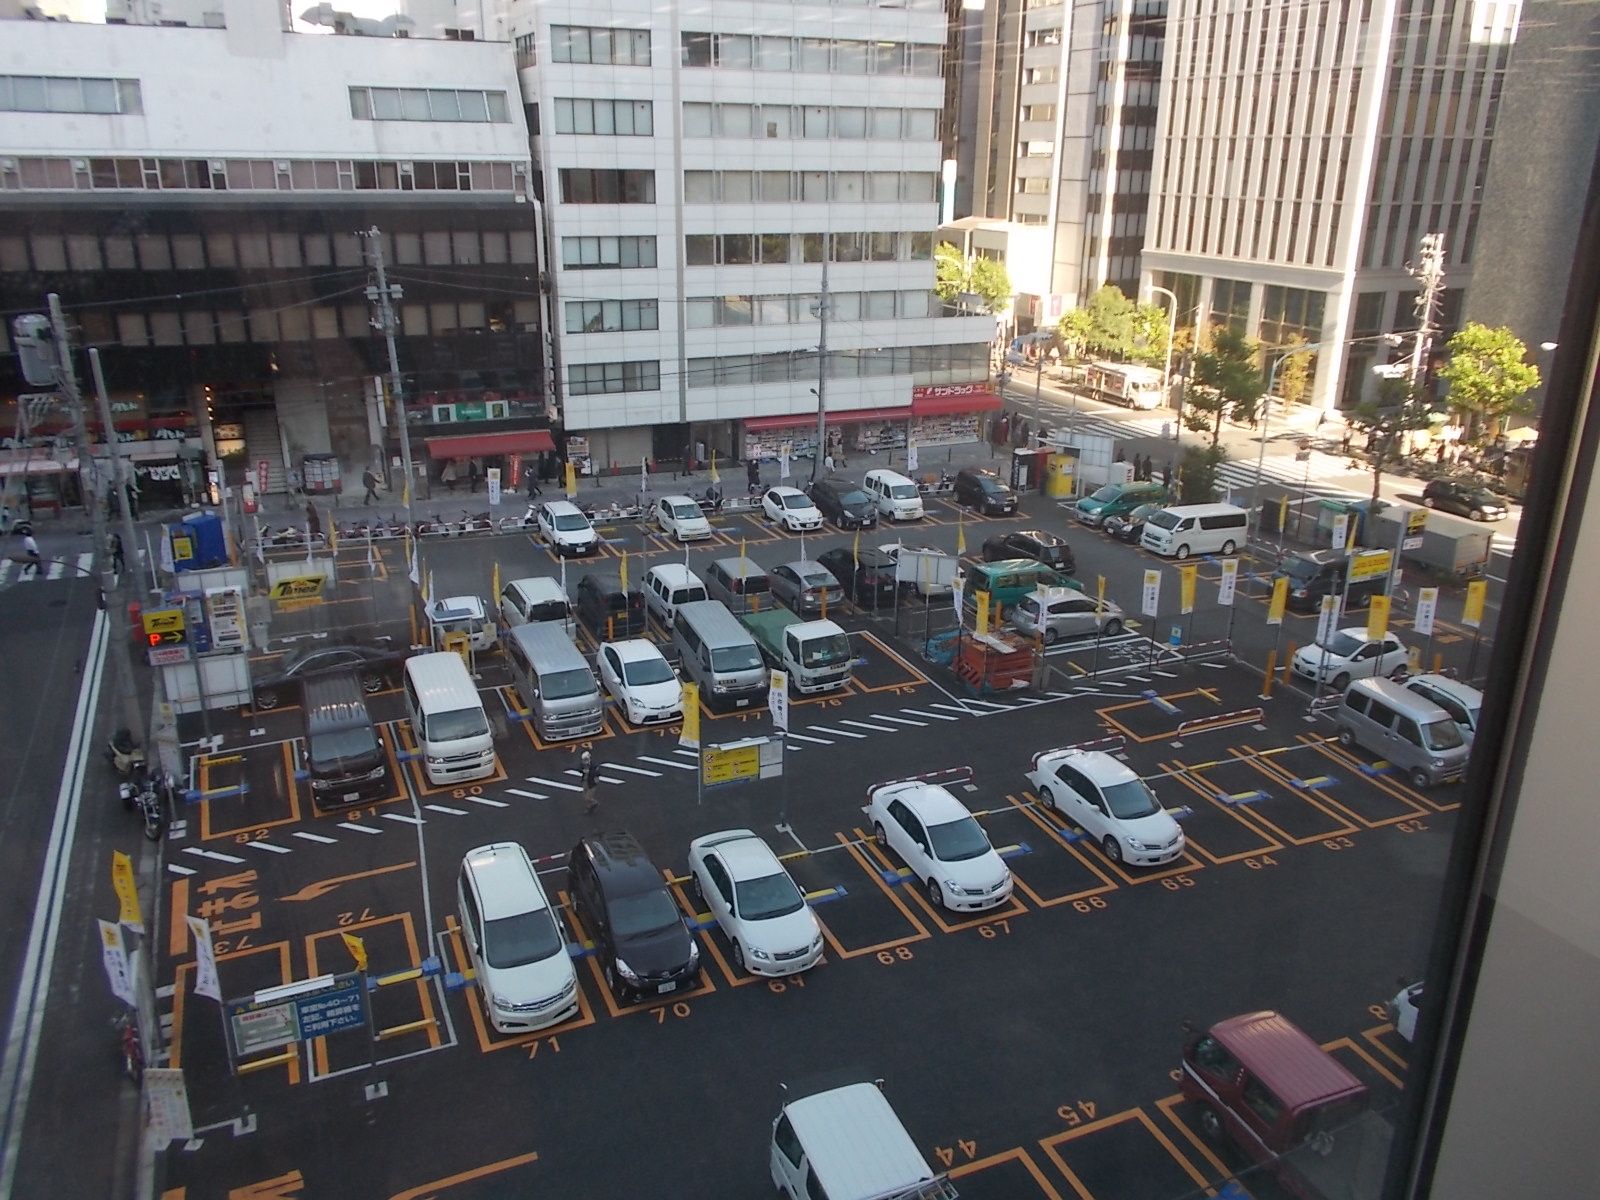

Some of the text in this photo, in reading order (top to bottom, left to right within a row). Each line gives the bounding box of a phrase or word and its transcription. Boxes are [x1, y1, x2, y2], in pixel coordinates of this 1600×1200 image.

[934, 385, 973, 396] サンドラッグ
[278, 578, 321, 596] Times
[149, 634, 160, 646] P
[736, 711, 761, 722] 77
[453, 785, 484, 799] 80
[347, 806, 377, 820] 81
[1397, 818, 1429, 833] 62
[234, 828, 270, 844] 82
[1322, 836, 1355, 851] 63
[1243, 855, 1279, 870] 64
[1160, 874, 1196, 892] 65
[1071, 895, 1107, 914] 66
[337, 908, 375, 926] 72
[978, 919, 1012, 939] 67
[213, 936, 253, 955] 73
[875, 946, 914, 966] 68
[650, 1003, 691, 1024] 70
[521, 1036, 560, 1060] 71
[1057, 1099, 1097, 1124] 45
[935, 1138, 976, 1166] 44
